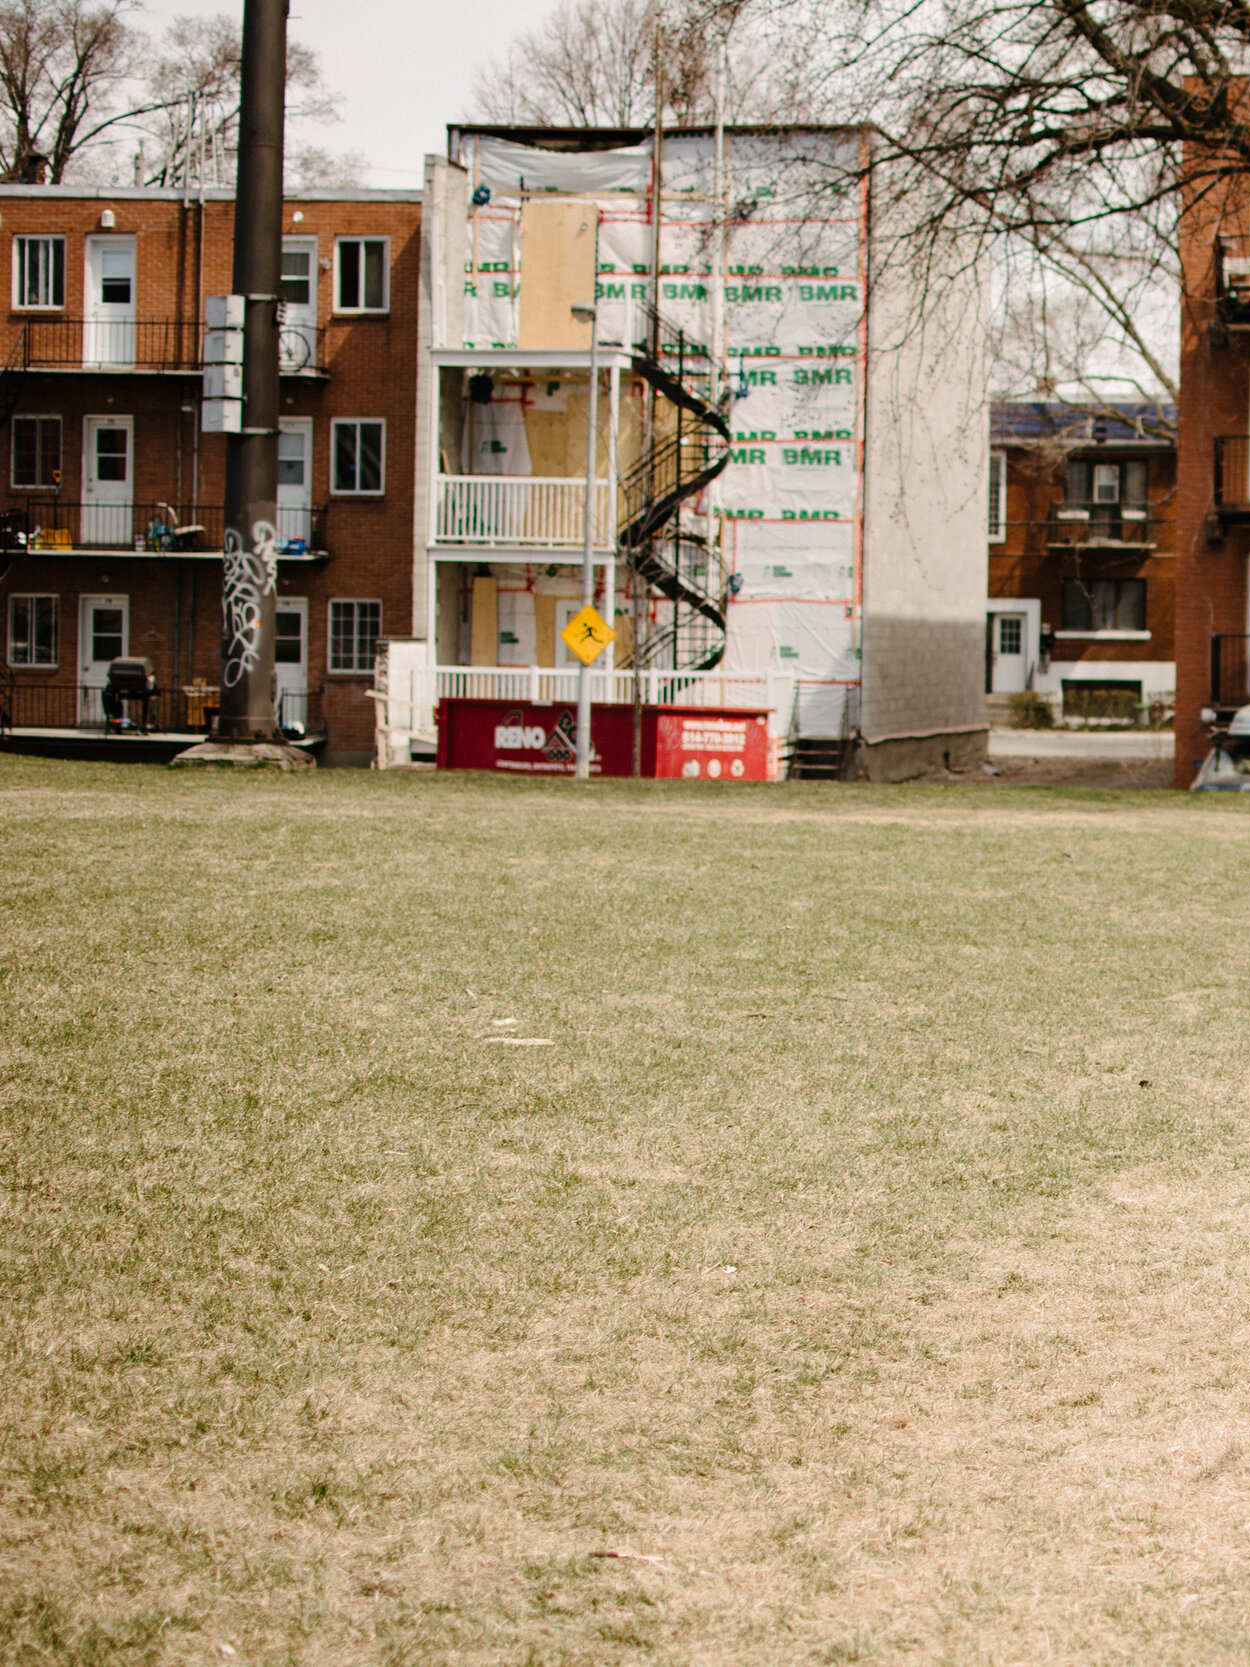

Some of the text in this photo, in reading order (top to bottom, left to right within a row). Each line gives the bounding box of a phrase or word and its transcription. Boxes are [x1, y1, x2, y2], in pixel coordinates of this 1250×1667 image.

[595, 283, 646, 299] BMR
[724, 285, 782, 302] BMR
[800, 285, 857, 301] BMR
[794, 369, 852, 385] BMR
[783, 448, 842, 466] BMR
[494, 725, 546, 749] RENO
